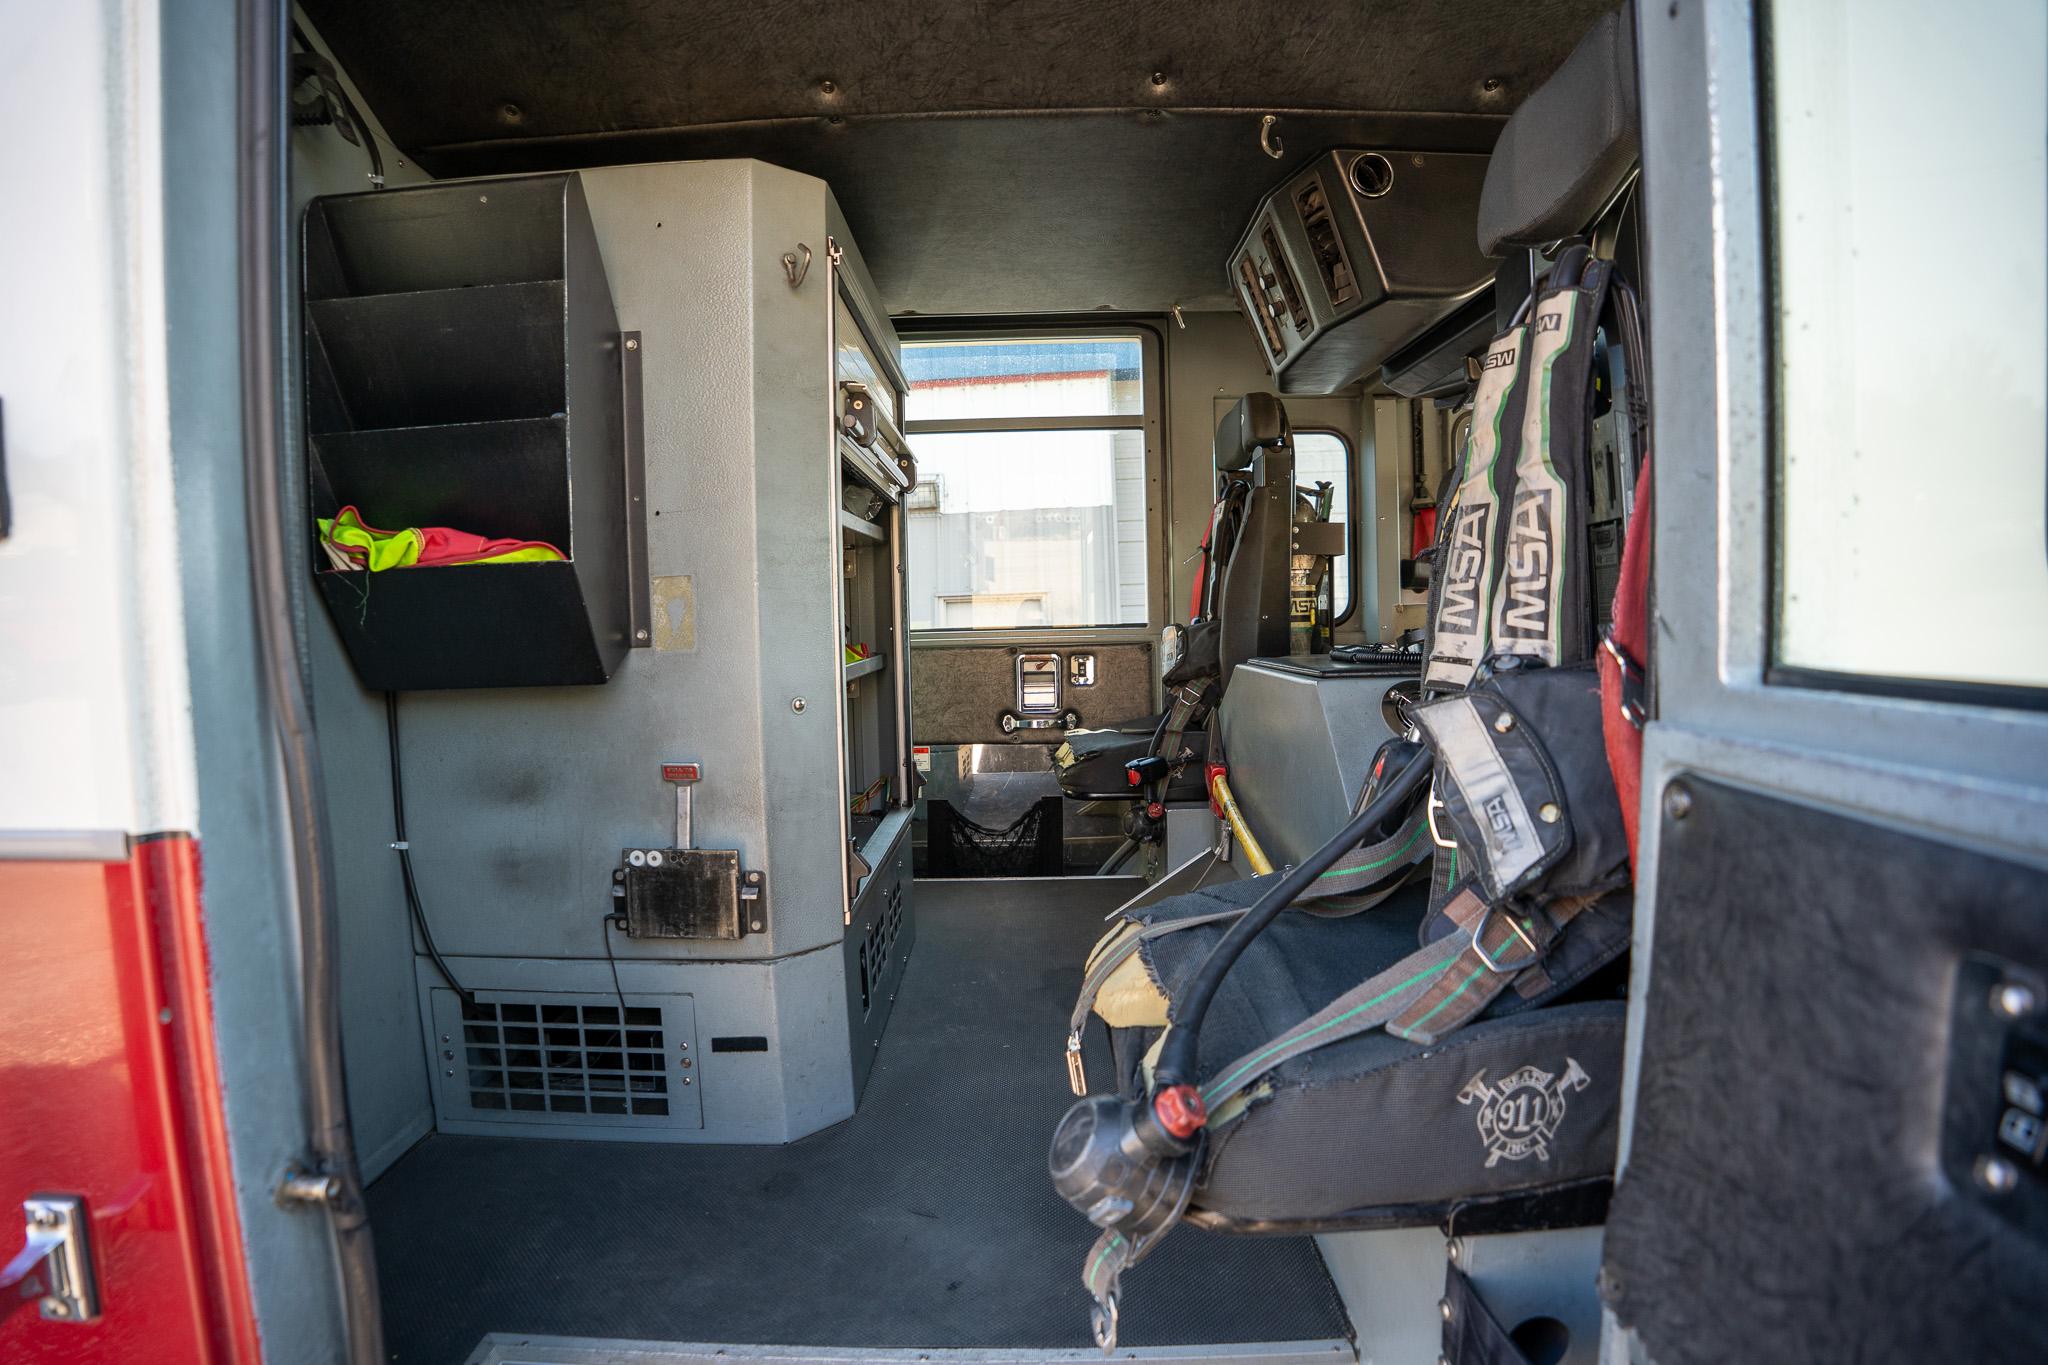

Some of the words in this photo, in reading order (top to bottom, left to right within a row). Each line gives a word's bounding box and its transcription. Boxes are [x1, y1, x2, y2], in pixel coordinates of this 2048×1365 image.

[1485, 350, 1514, 369] MS
[1441, 507, 1486, 628] MSA
[1506, 494, 1548, 632] MSA
[1498, 1093, 1543, 1132] 911
